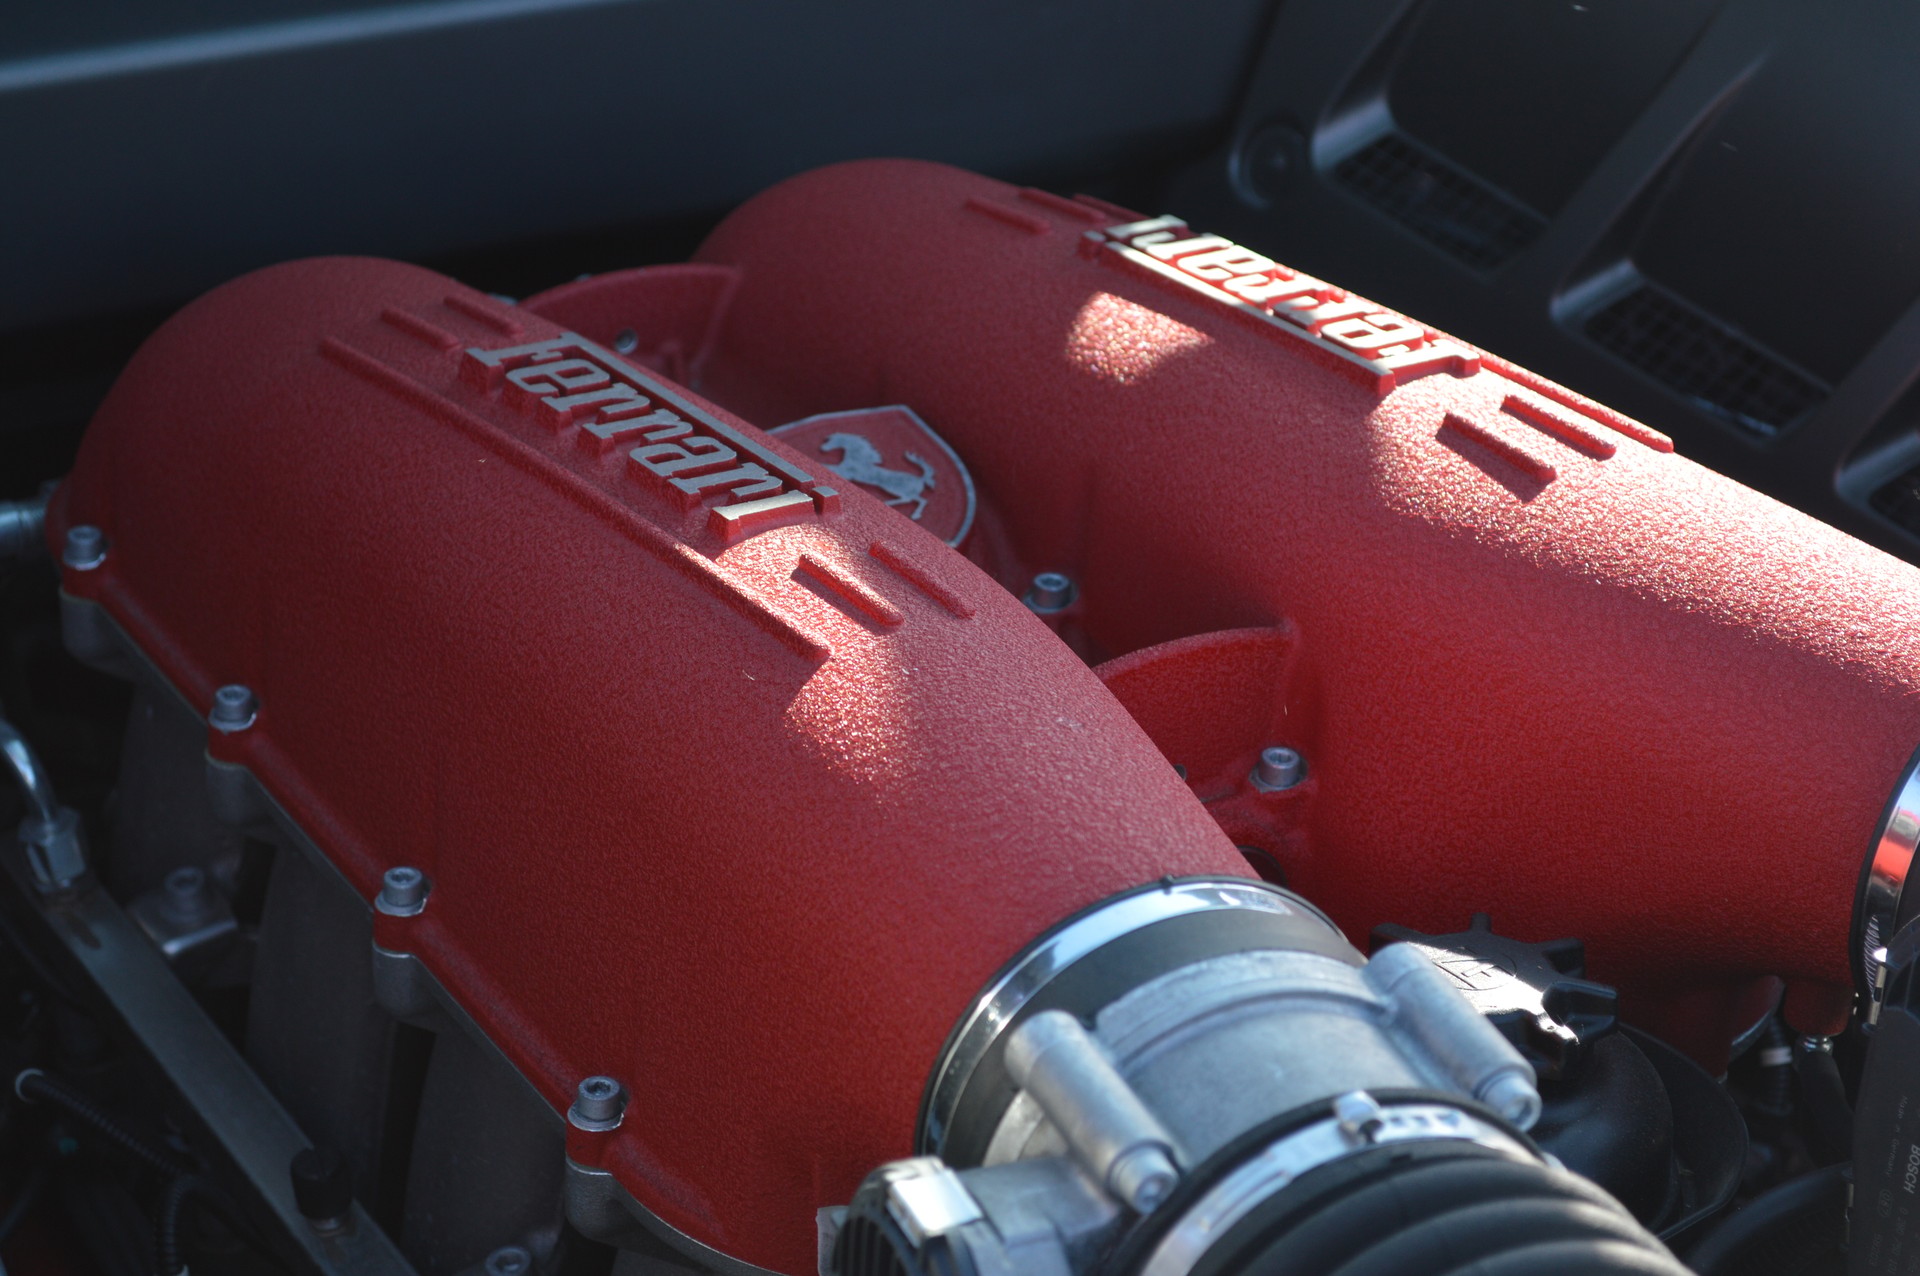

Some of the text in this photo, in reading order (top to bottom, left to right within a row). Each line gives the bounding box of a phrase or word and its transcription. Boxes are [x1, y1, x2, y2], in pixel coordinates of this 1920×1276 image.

[1083, 213, 1480, 377] Ferrari
[465, 331, 840, 522] Ferrari
[1898, 1095, 1908, 1119] Made
[1903, 1144, 1920, 1194] BOSCH
